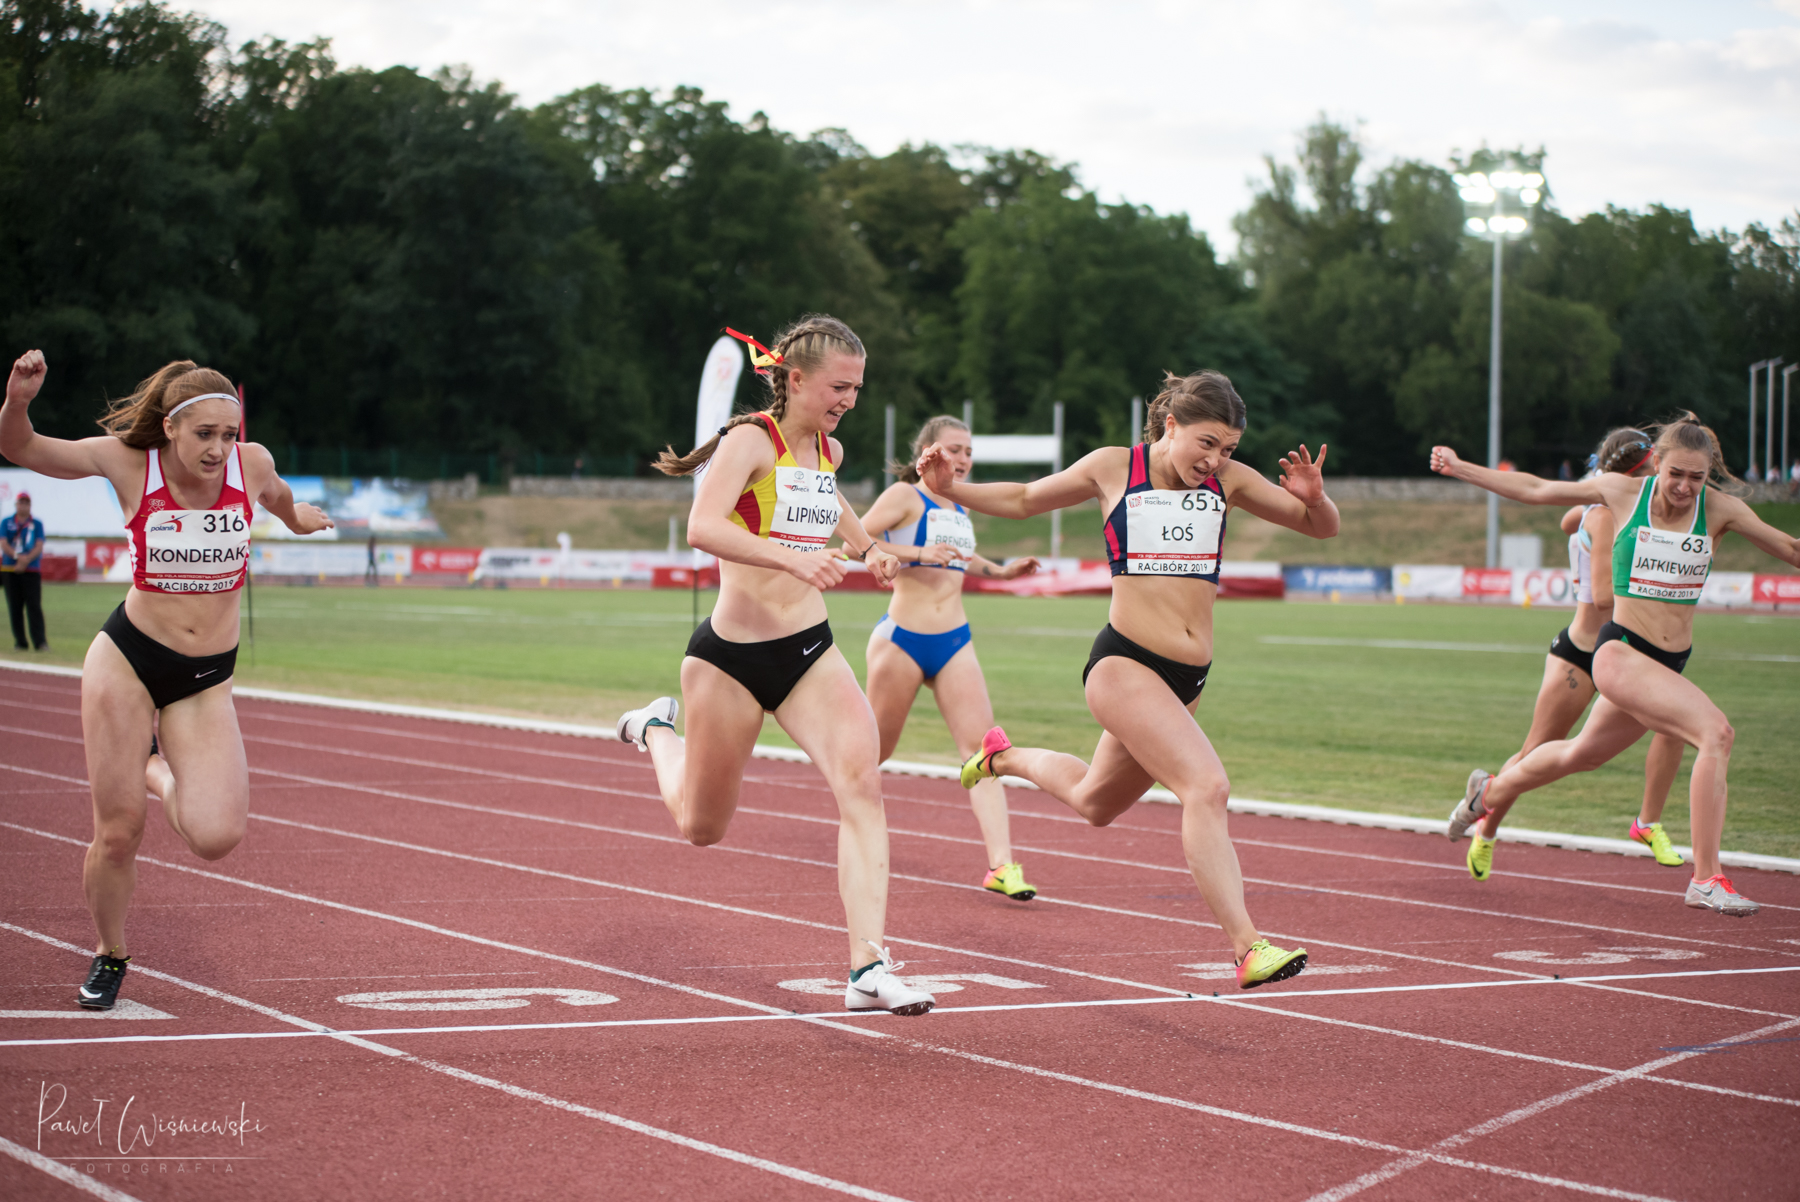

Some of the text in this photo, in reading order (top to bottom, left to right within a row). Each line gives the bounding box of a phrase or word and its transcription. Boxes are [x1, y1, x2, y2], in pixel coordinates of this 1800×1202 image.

[1181, 493, 1221, 511] 651
[203, 513, 244, 533] 316
[786, 505, 838, 525] LIPIŃSKA
[1161, 523, 1194, 541] ŁOŚ
[935, 534, 973, 549] BRENDEL
[149, 545, 246, 563] KONDERAK
[1137, 561, 1208, 572] RACIBÓRZ 2019
[1635, 557, 1707, 576] JATKIEWICZ
[157, 580, 234, 591] RACIBÓRZ 2019
[1637, 586, 1694, 598] RACIBÓRZ 2019
